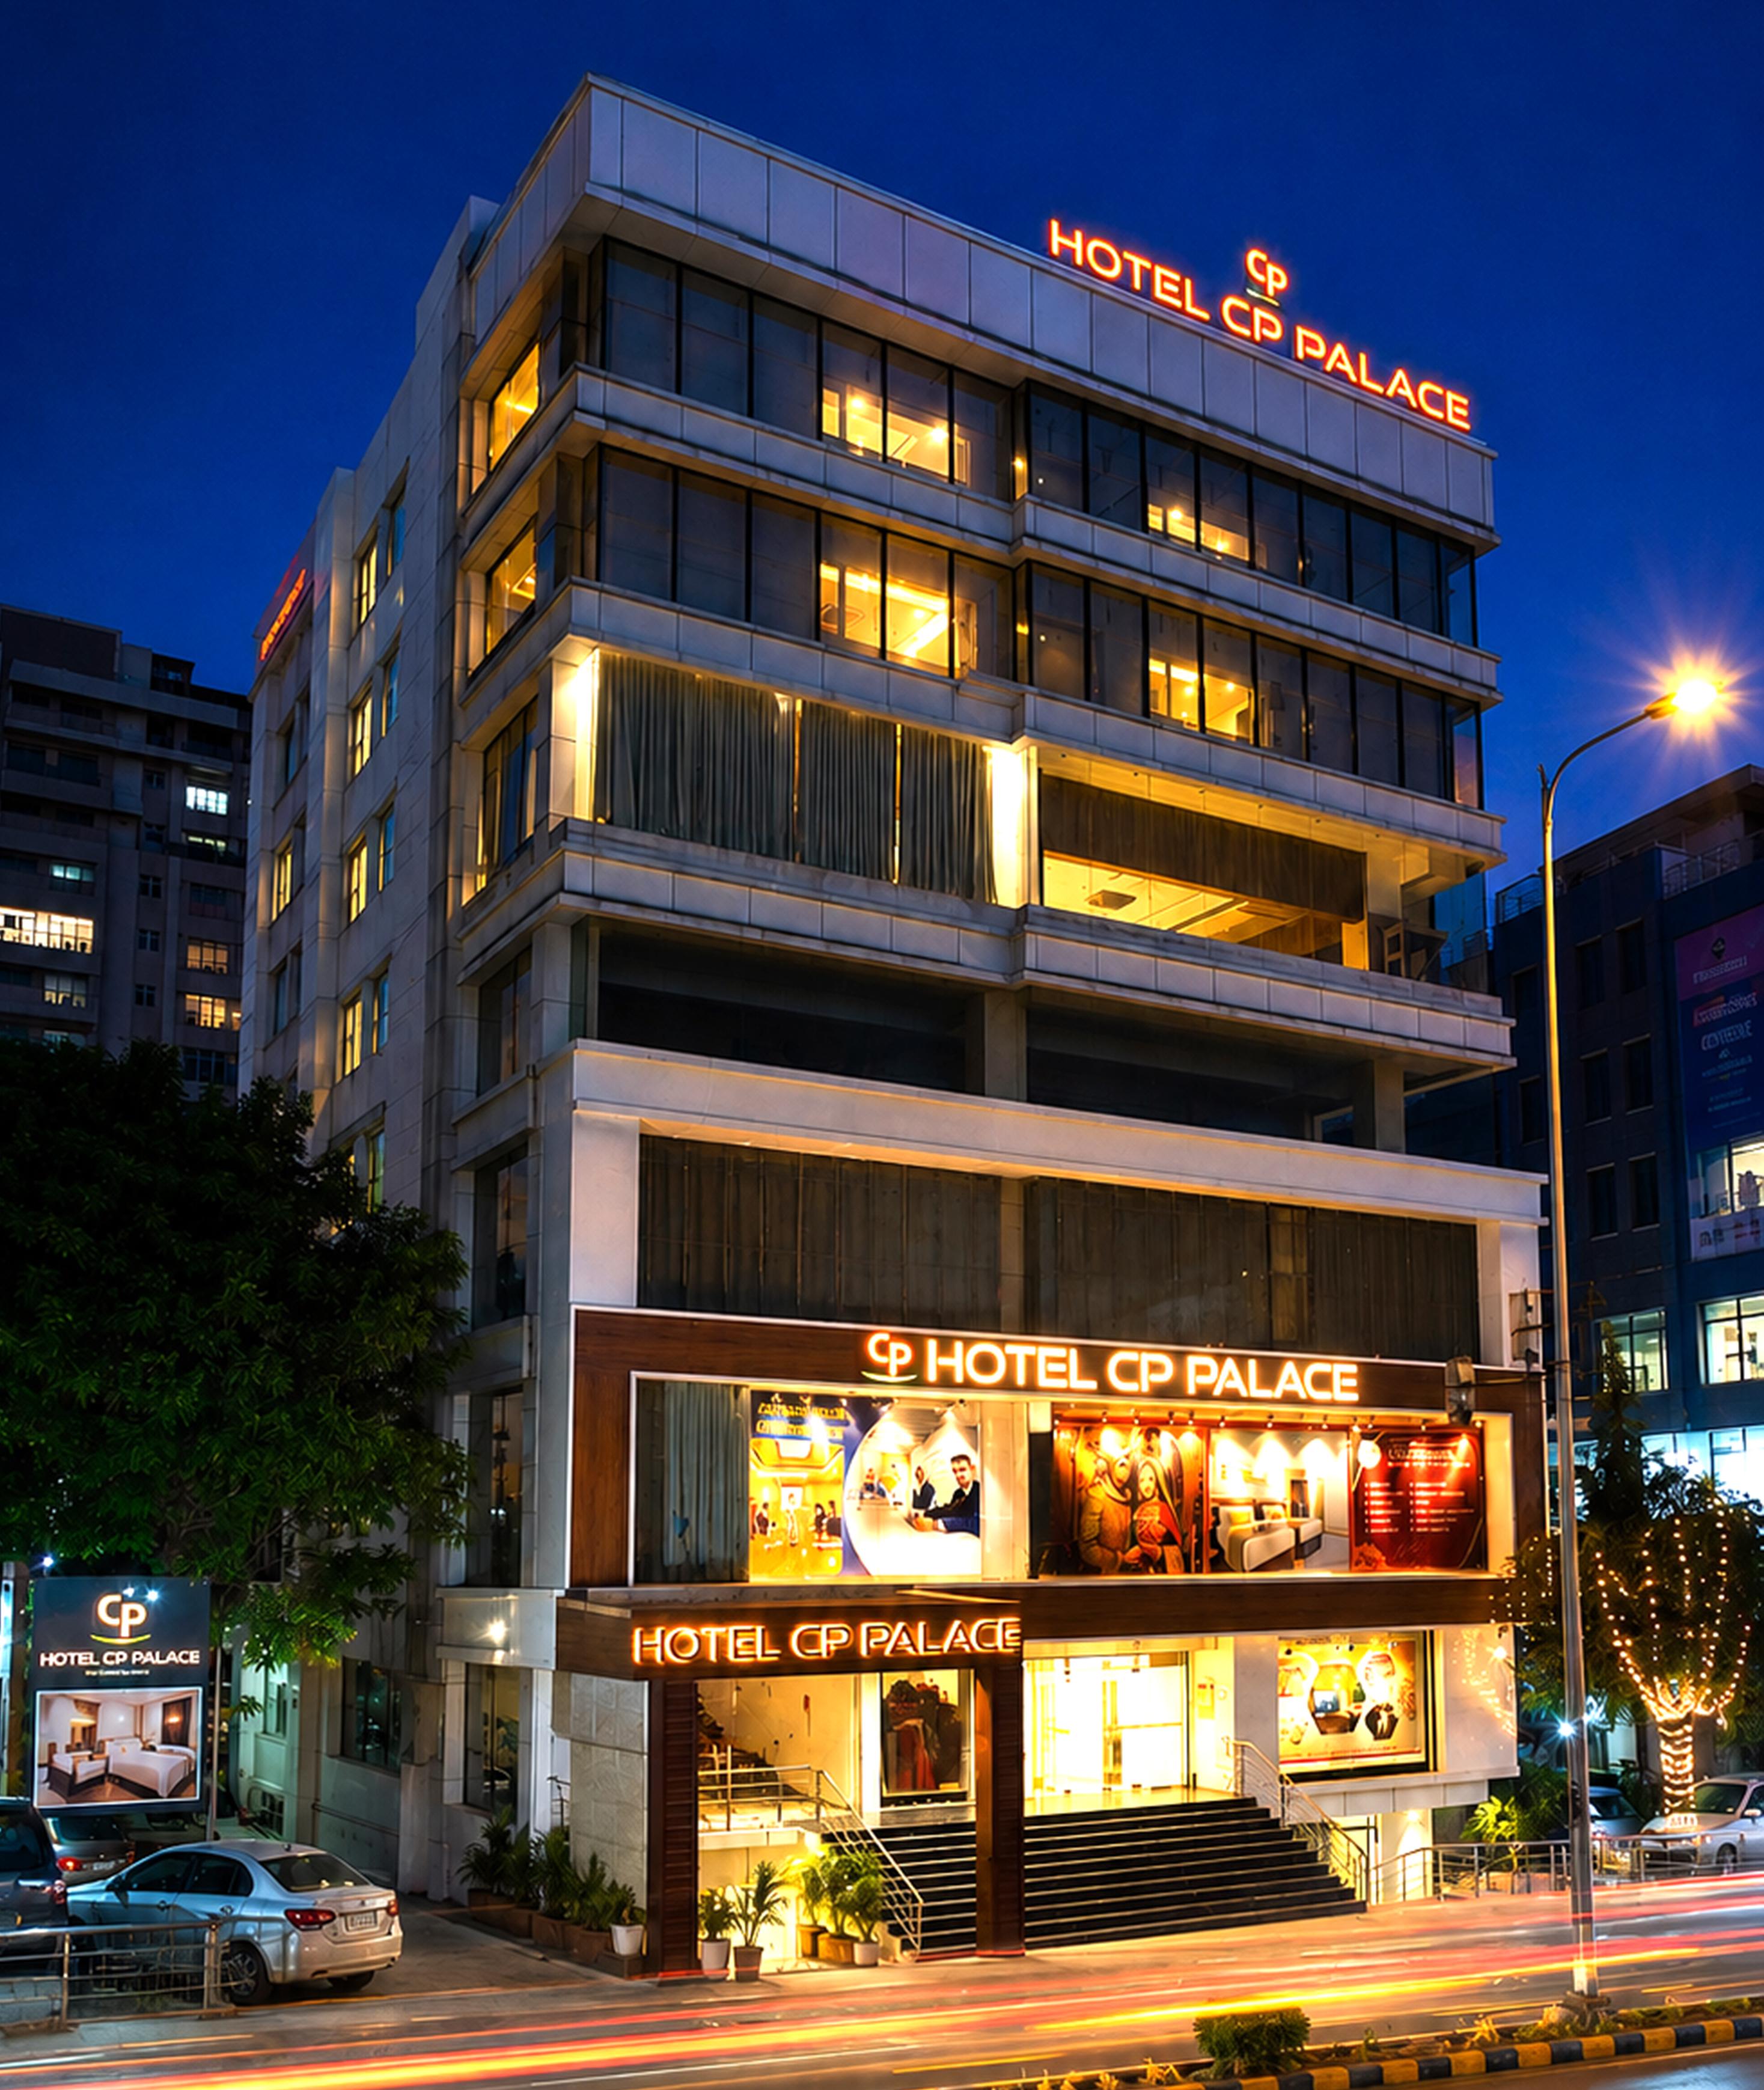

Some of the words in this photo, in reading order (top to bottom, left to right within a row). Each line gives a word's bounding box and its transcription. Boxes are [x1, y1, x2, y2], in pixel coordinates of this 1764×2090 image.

[1245, 248, 1288, 297] CP
[1049, 218, 1210, 321] HOTEL
[1221, 295, 1283, 342] CP
[1295, 325, 1471, 432] PALACE
[867, 1332, 912, 1377] CP
[927, 1338, 1098, 1391] HOTEL
[1107, 1351, 1173, 1393] CP
[1188, 1357, 1359, 1402] PALACE
[97, 1593, 147, 1638] CP
[40, 1651, 100, 1667] HOTEL
[103, 1651, 128, 1665] CP
[132, 1649, 200, 1664] PALACE
[633, 1625, 781, 1664] HOTEL
[790, 1623, 850, 1659] CP
[860, 1617, 1021, 1657] PALACE
